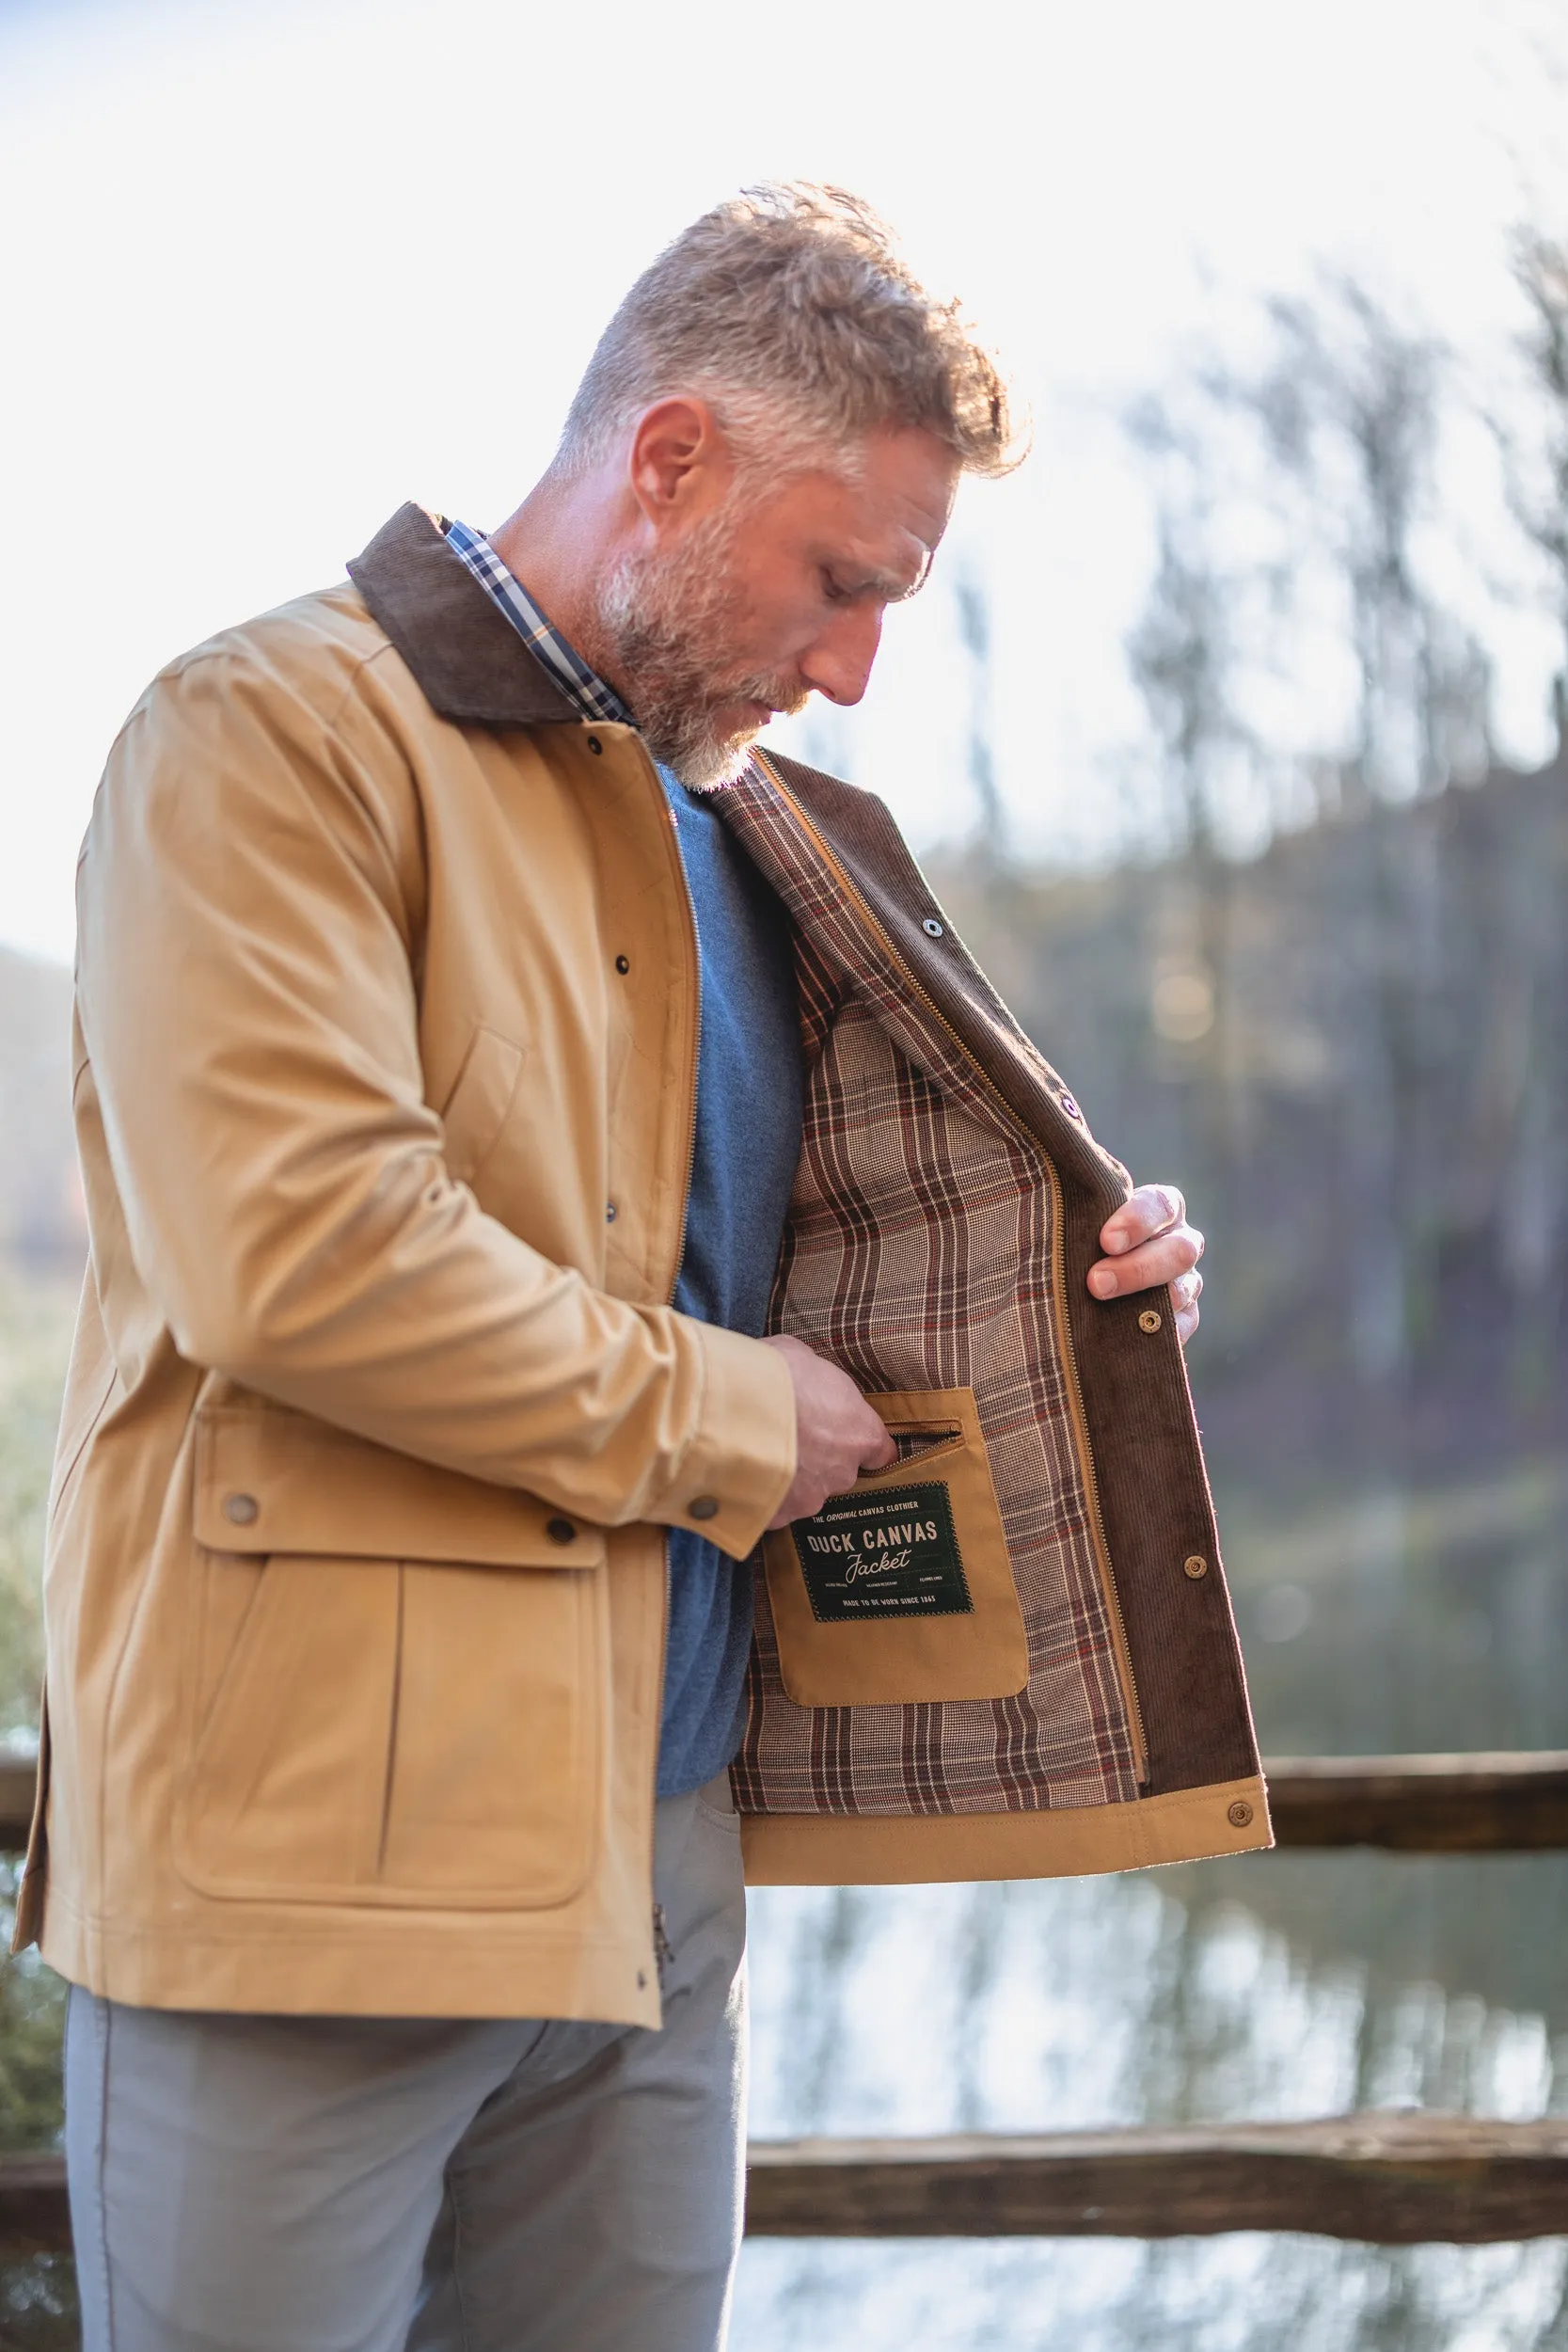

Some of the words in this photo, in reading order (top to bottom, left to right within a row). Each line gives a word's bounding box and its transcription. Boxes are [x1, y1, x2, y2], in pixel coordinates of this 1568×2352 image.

[826, 1511, 858, 1522] ORIGINAL
[858, 1506, 884, 1517] CANVAS
[886, 1501, 919, 1512] CLOTHIER
[807, 1533, 856, 1553] DUCK
[863, 1520, 938, 1550] CANVAS
[845, 1549, 912, 1584] Jacket
